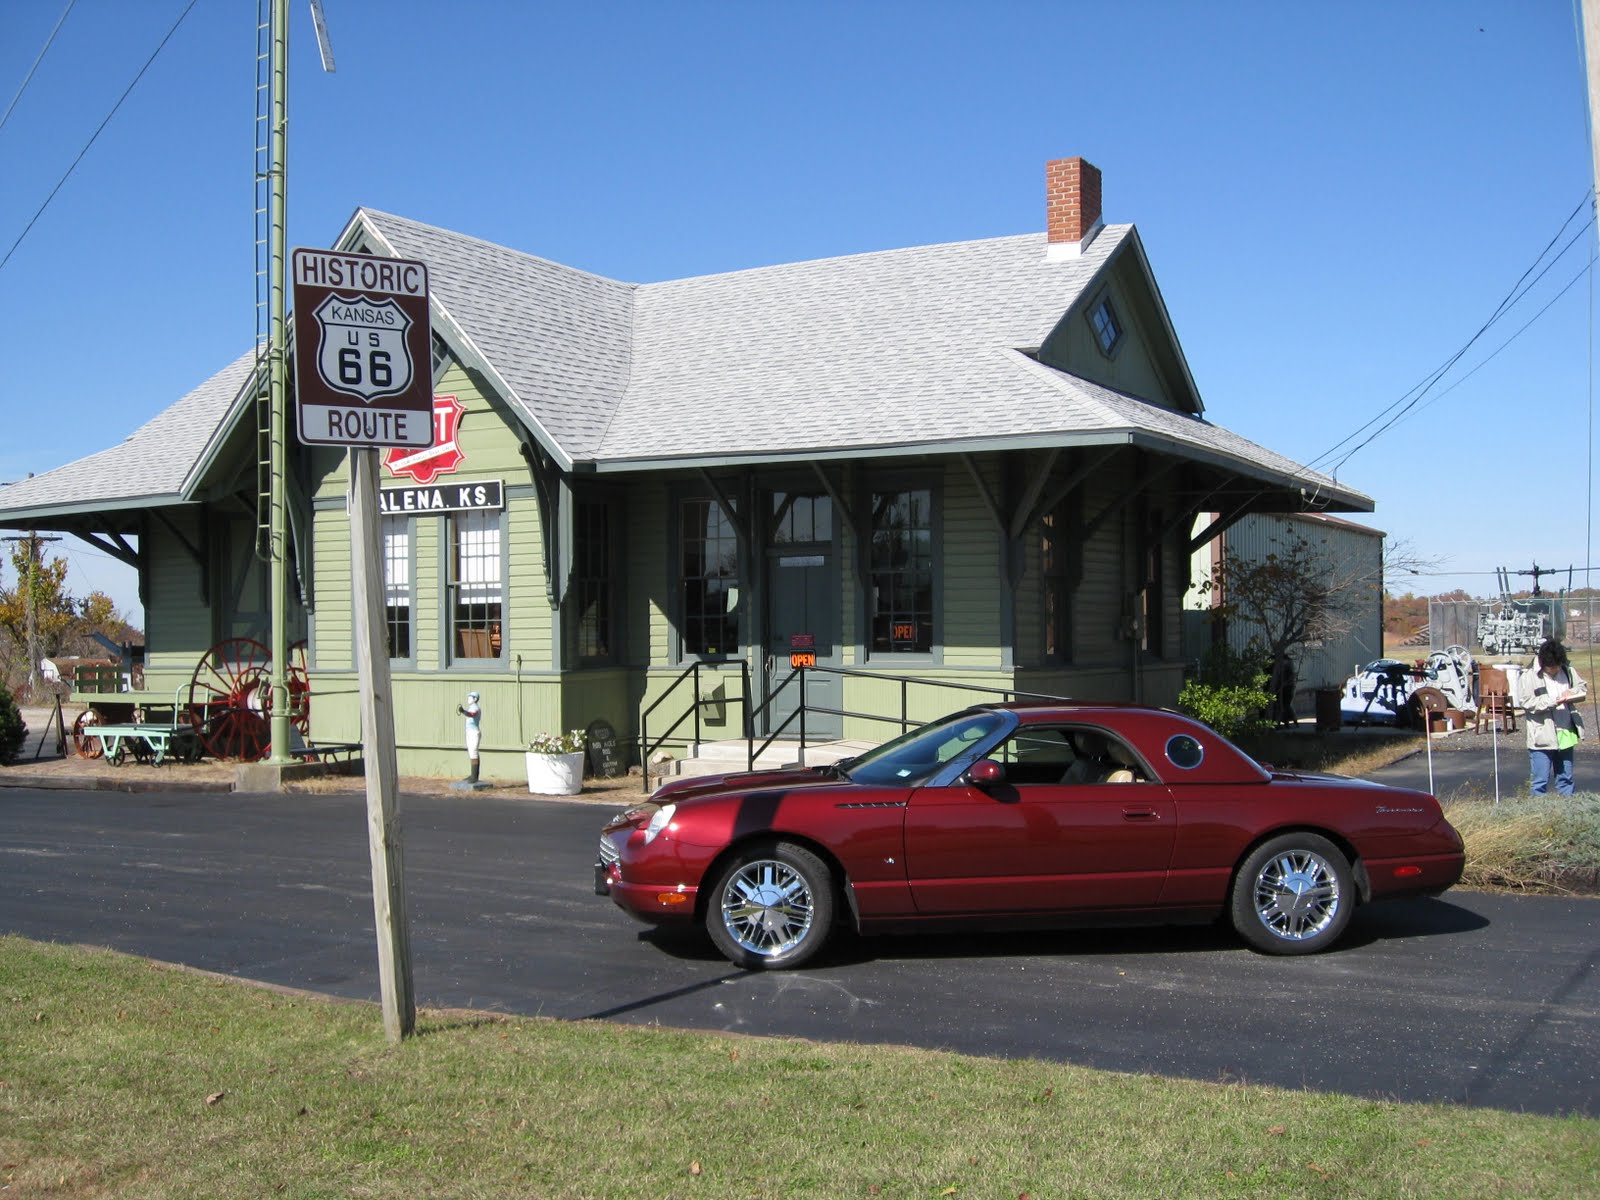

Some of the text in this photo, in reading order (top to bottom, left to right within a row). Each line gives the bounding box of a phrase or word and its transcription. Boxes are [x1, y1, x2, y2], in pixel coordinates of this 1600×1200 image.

[302, 255, 419, 293] HISTORIC
[331, 305, 395, 325] KANSAS
[338, 347, 393, 387] 66
[327, 409, 408, 440] ROUTE
[791, 653, 816, 667] OPEN
